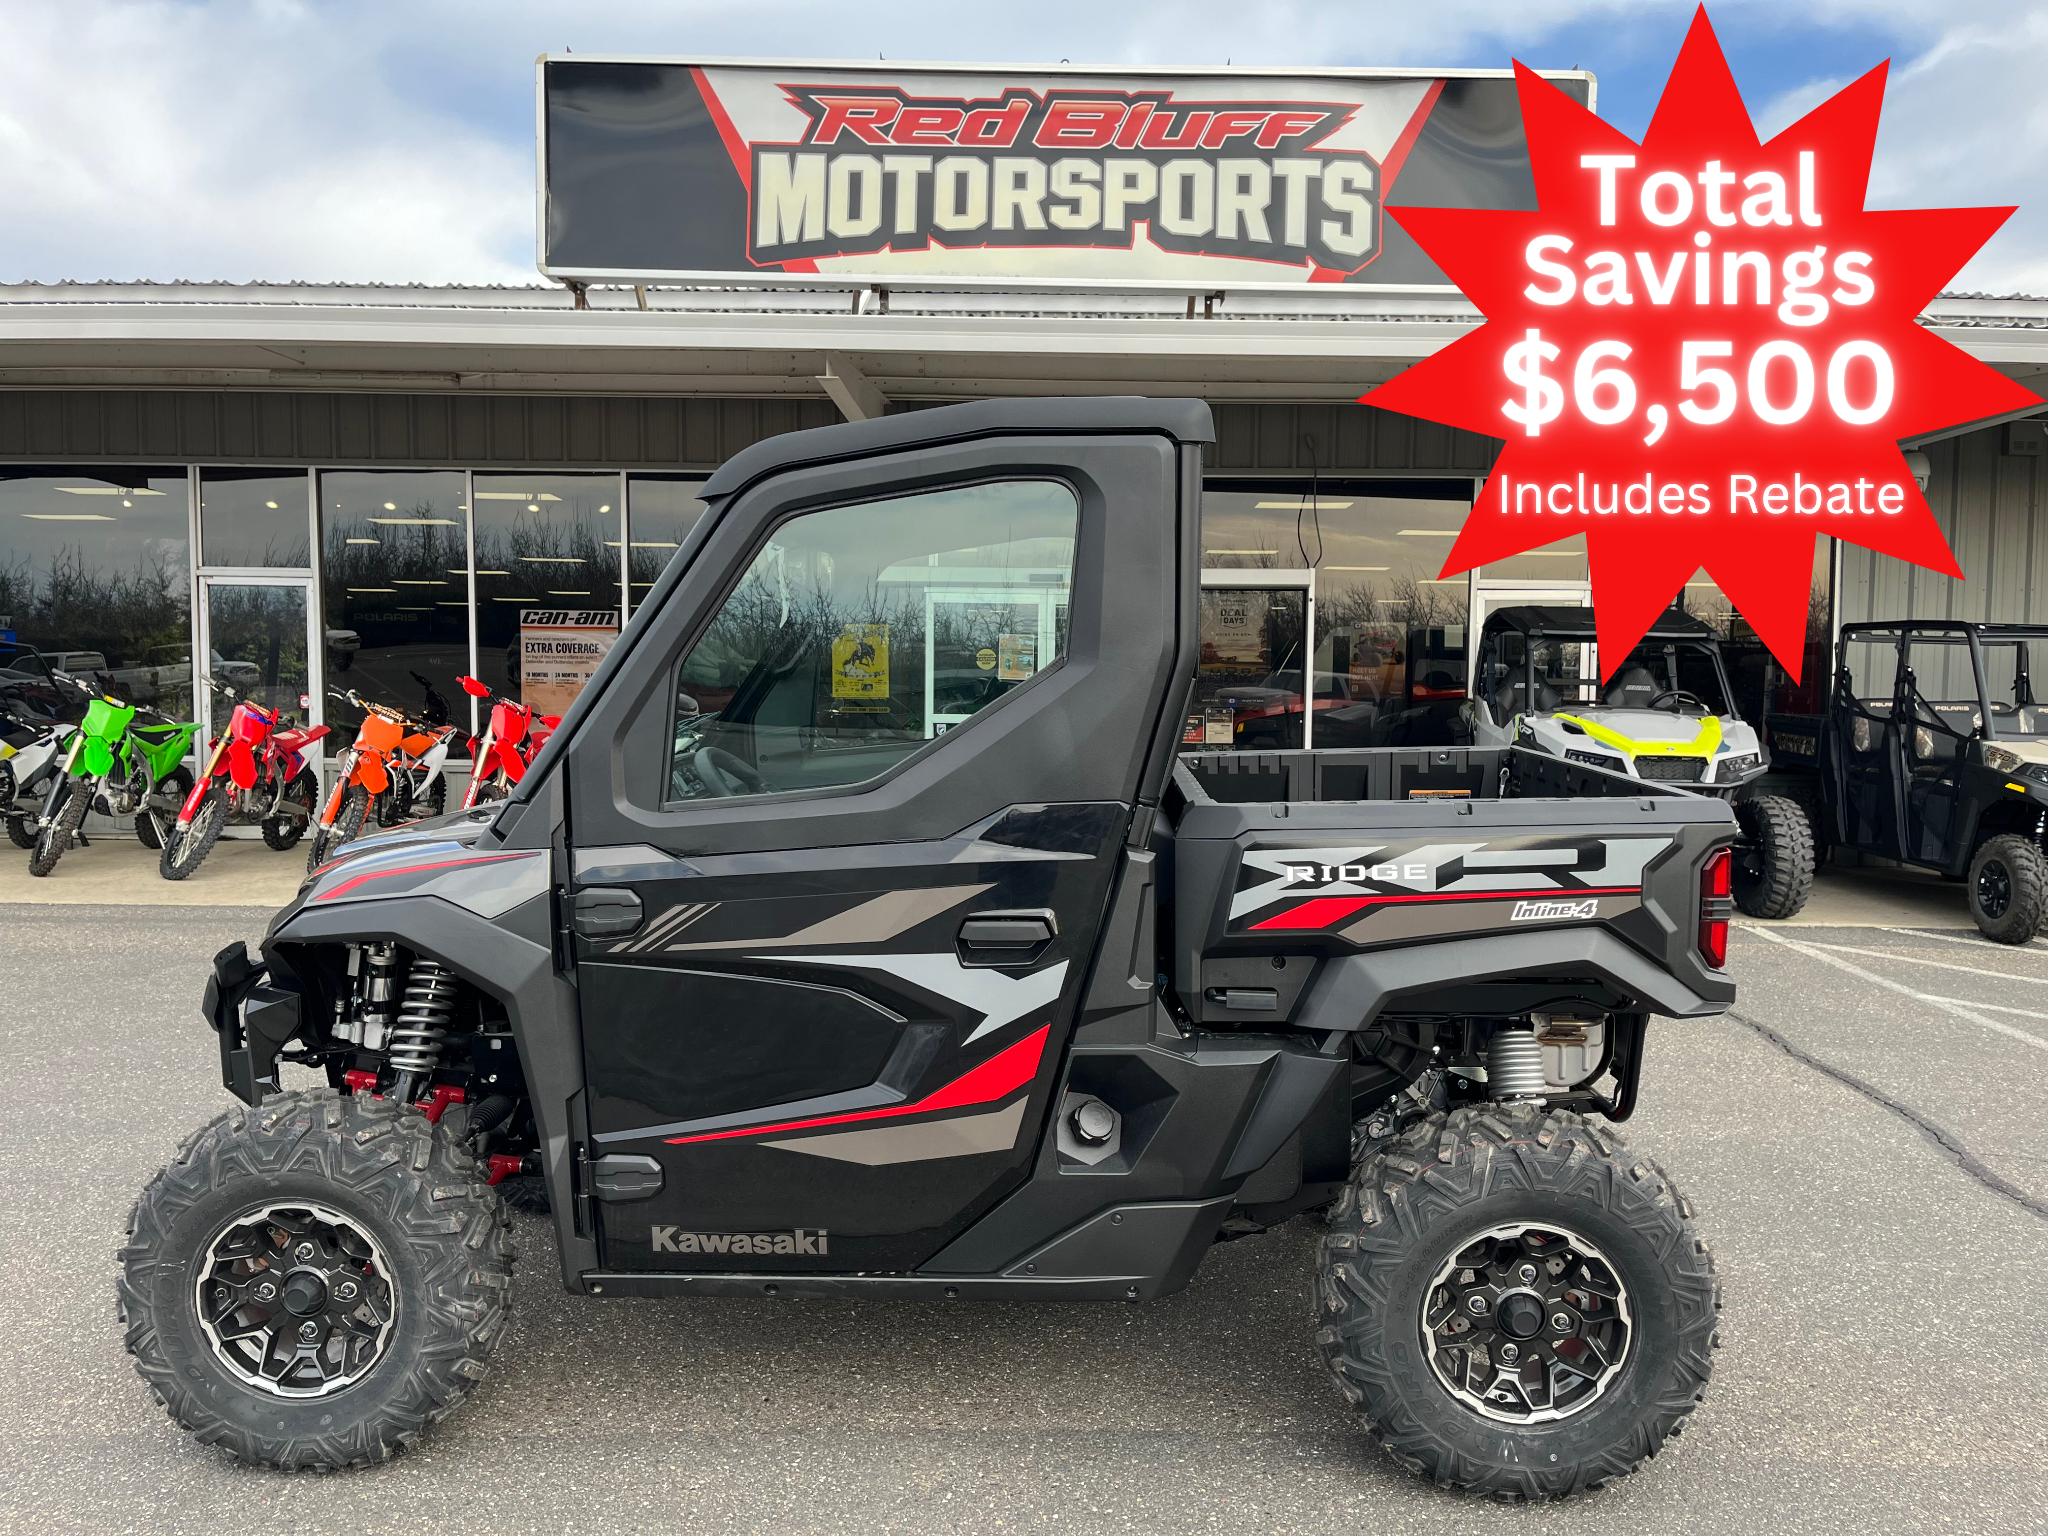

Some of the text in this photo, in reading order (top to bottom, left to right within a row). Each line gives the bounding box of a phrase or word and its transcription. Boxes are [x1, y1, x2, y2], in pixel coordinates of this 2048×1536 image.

[810, 95, 1032, 147] Red
[756, 151, 1374, 257] MOTORSPORTS
[353, 613, 418, 621] POLARIS
[522, 611, 614, 626] can-am
[1220, 608, 1248, 617] DEAL
[525, 642, 600, 654] EXTRA COVERAGE
[1780, 736, 1812, 745] RANGER
[1988, 750, 2012, 762] 570
[1286, 864, 1428, 882] RIDGE
[1510, 900, 1598, 921] Inline-4
[652, 1226, 828, 1254] Kawasaki
